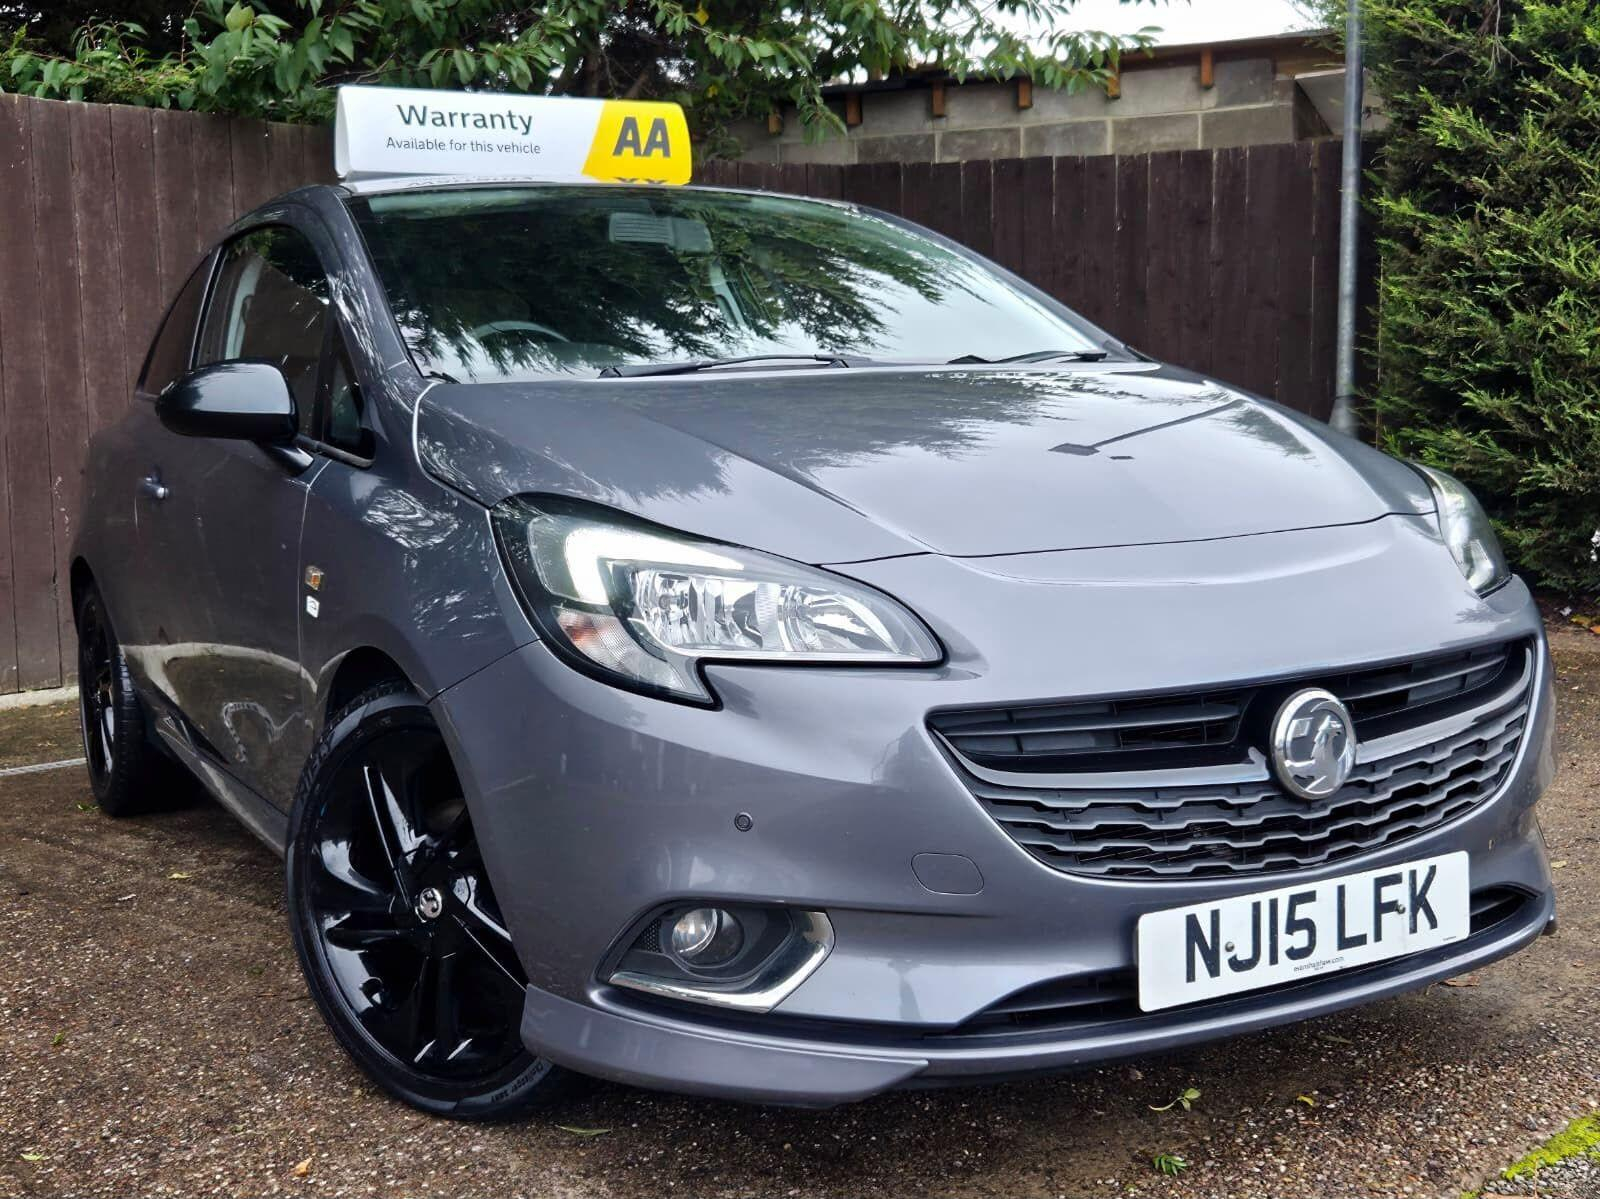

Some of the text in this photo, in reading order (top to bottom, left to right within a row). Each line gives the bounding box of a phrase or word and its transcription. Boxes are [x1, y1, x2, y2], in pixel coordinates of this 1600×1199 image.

[396, 104, 533, 135] Warranty
[612, 117, 671, 158] AA
[386, 137, 541, 155] Available for this vehicle
[1186, 865, 1438, 983] NJ15 LFK
